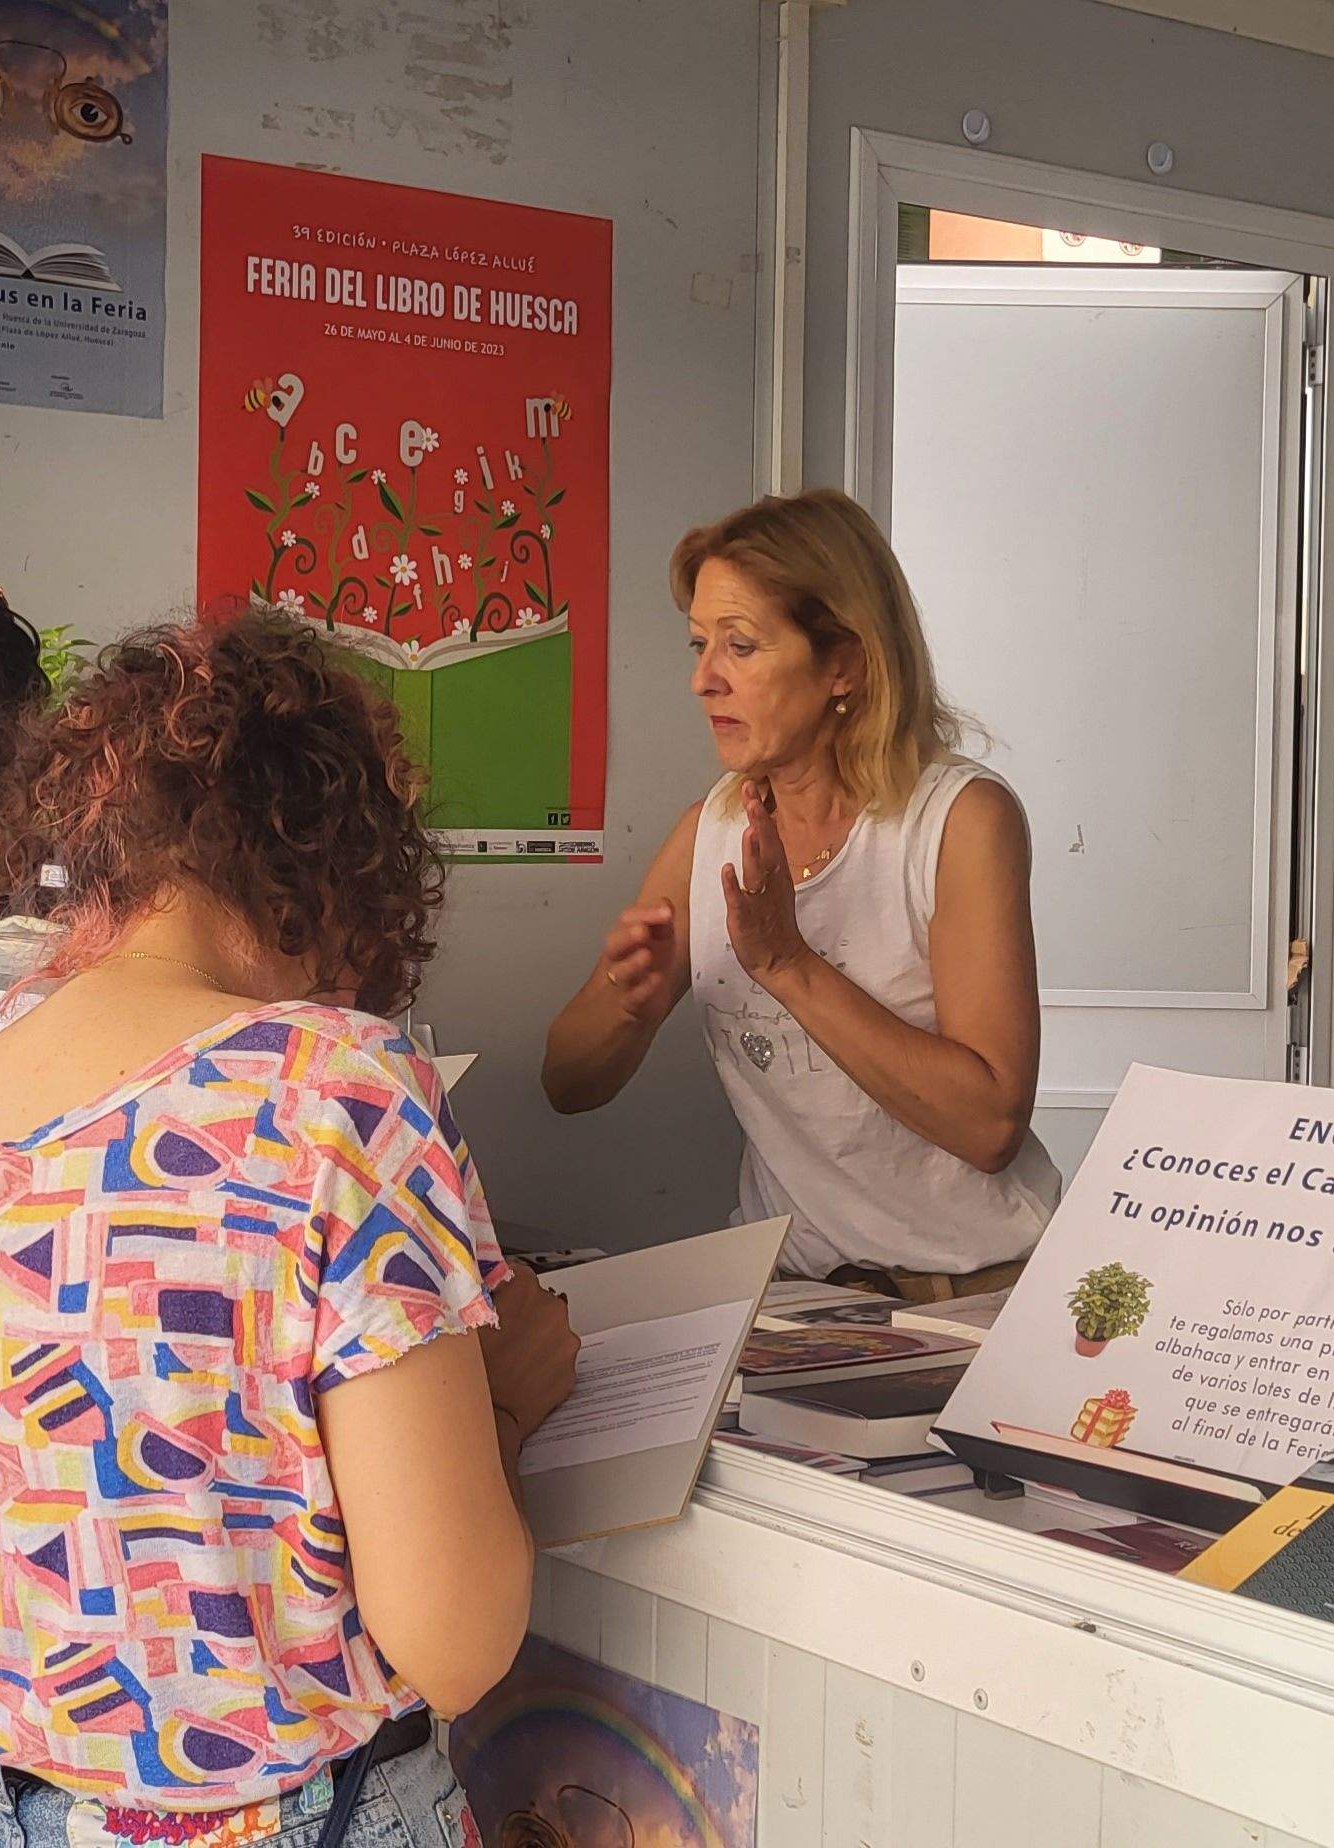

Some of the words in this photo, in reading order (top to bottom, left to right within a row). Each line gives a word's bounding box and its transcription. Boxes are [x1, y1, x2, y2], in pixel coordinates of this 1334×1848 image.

[292, 224, 311, 240] 39
[317, 228, 376, 249] EDICIÓN
[392, 240, 439, 259] PLAZA
[444, 246, 488, 266] LÓPEZ
[492, 255, 536, 274] ALLUÉ
[27, 292, 54, 309] en
[63, 292, 82, 312] la
[91, 296, 147, 321] Feria
[247, 255, 316, 301] FERIA
[325, 266, 367, 308] DEL
[376, 274, 445, 318] LIBRO
[453, 284, 482, 323] DE
[490, 289, 578, 335] HUESCA
[324, 323, 337, 336] 26
[340, 325, 354, 338] DE
[357, 327, 386, 342] MAYO
[388, 332, 402, 344] AL
[404, 333, 411, 345] 4
[414, 334, 427, 347] DE
[430, 337, 462, 350] JUNIO
[464, 341, 478, 353] DE
[481, 342, 505, 356] 2023
[1122, 1146, 1259, 1184] ¿Conoces
[1265, 1162, 1296, 1187] el
[1109, 1191, 1143, 1220] Tu
[1150, 1203, 1259, 1238] opinión
[1266, 1221, 1324, 1248] nos
[1222, 1299, 1255, 1317] Sólo
[1258, 1306, 1290, 1323] por
[1169, 1314, 1185, 1331] te
[1190, 1320, 1274, 1345] regalamos
[1279, 1335, 1313, 1351] una
[1155, 1337, 1231, 1365] albahaca
[1234, 1353, 1245, 1370] y
[1249, 1354, 1301, 1375] entrar
[1306, 1366, 1329, 1382] en
[1171, 1364, 1193, 1383] de
[1199, 1373, 1247, 1393] varios
[1252, 1377, 1291, 1400] lotes
[1297, 1388, 1321, 1406] de
[1185, 1395, 1217, 1412] que
[1221, 1401, 1241, 1417] se
[1171, 1415, 1190, 1433] al
[1192, 1418, 1231, 1441] final
[1236, 1428, 1257, 1447] de
[1261, 1431, 1280, 1451] la
